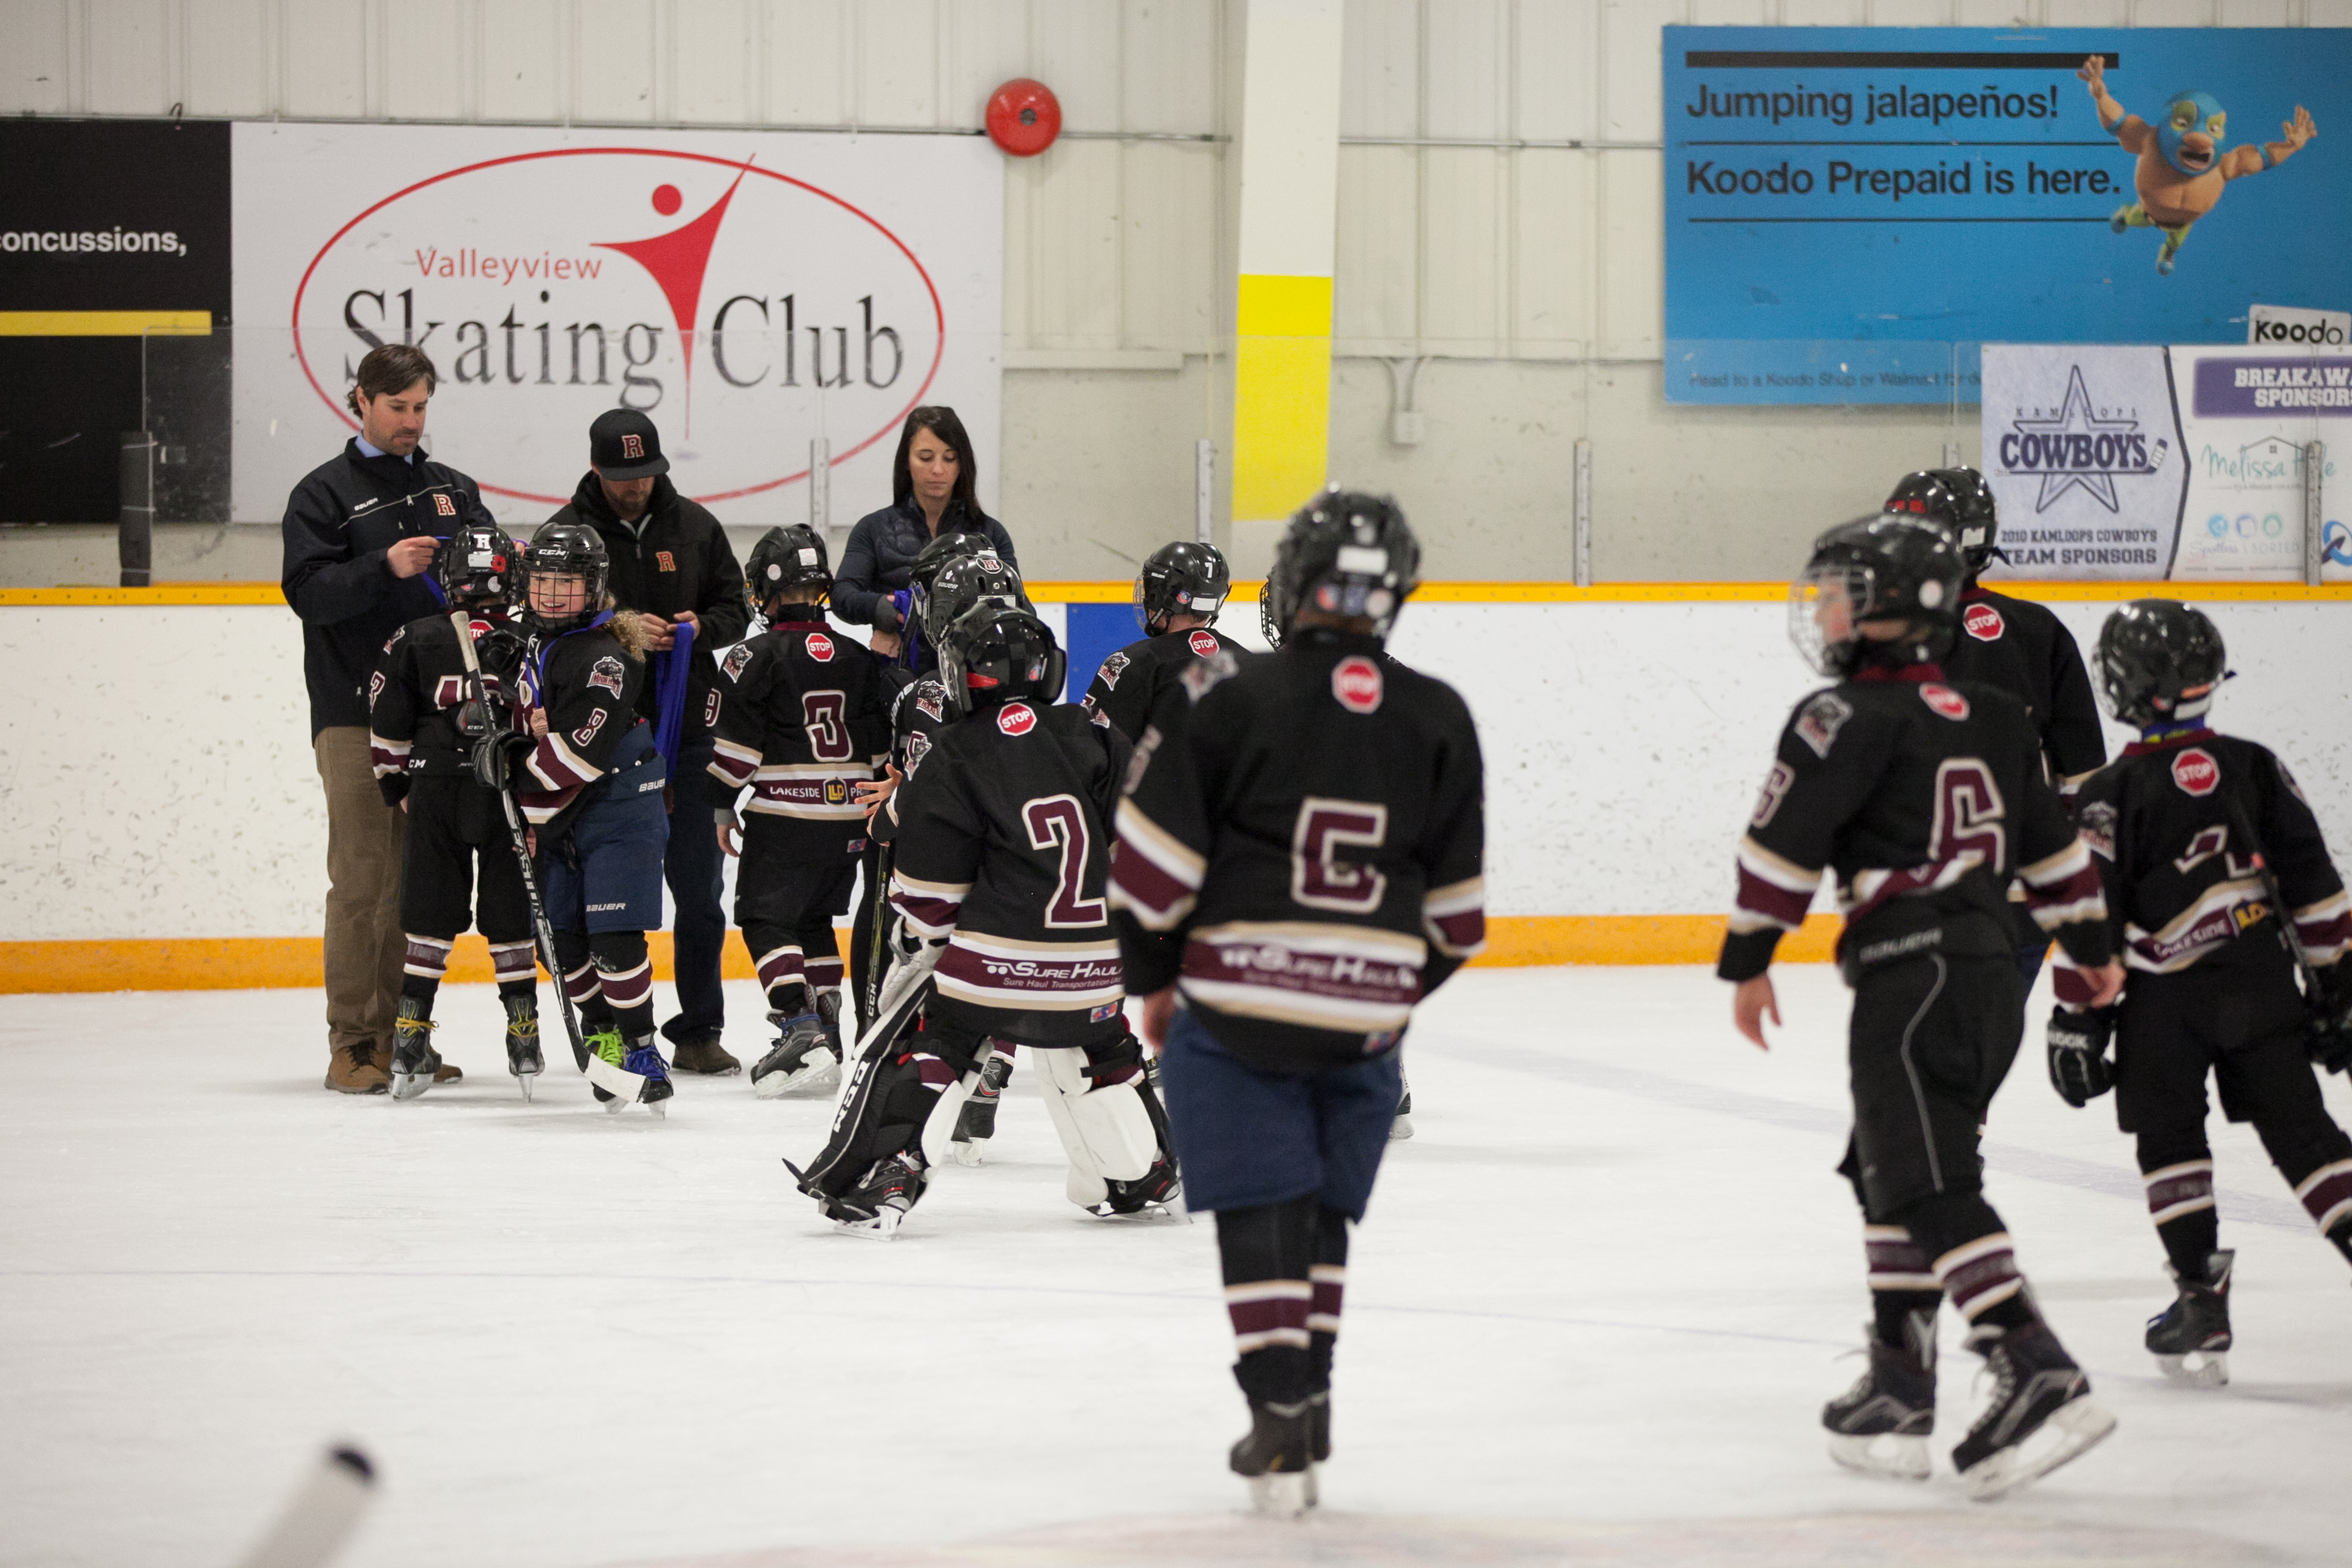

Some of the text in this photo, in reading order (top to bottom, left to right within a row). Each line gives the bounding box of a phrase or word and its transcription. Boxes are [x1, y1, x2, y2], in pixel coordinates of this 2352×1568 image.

[1686, 84, 2057, 126] Jumping jalapeños!
[1687, 161, 2121, 201] Koodo Prepaid is here.
[0, 226, 188, 257] oncussions,
[416, 248, 602, 286] Valleyview
[345, 288, 903, 412] Skating Club
[2235, 368, 2352, 387] BREAKAW
[2255, 388, 2352, 407] SPONSOR
[622, 434, 644, 459] R
[2001, 433, 2148, 468] COWBOYS
[433, 493, 456, 515] R
[2031, 530, 2093, 542] KAMLOOPS
[2097, 530, 2157, 542] COWBOYS
[656, 551, 676, 572] R
[2061, 549, 2157, 564] SPONSORS
[1968, 614, 1997, 631] STOP
[809, 642, 830, 652] STOP
[1193, 639, 1215, 651] STOP
[572, 707, 607, 747] 8
[1001, 710, 1031, 728] STOP
[409, 760, 427, 768] CM
[770, 786, 820, 798] LAKESIDE
[1021, 794, 1108, 928] 2
[510, 829, 545, 920] EASTON
[1004, 977, 1024, 987] Sure
[1026, 980, 1048, 988] Haul
[1051, 978, 1109, 990] Transportation
[867, 983, 877, 1017] CCM
